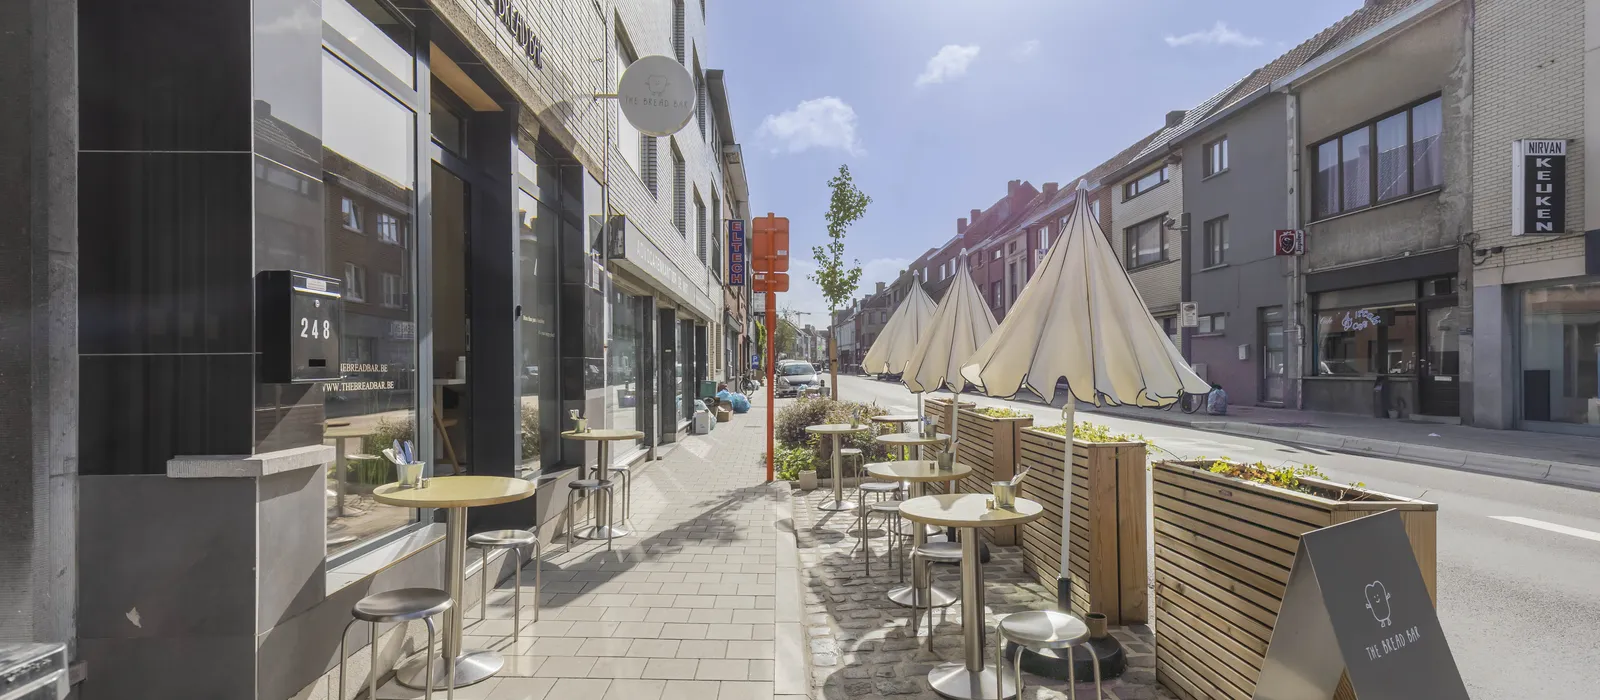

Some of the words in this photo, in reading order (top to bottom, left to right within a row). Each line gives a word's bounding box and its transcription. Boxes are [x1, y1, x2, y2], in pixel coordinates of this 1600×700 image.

[625, 95, 638, 105] THE
[643, 98, 669, 108] BREAD
[673, 101, 688, 109] BAR
[1528, 141, 1562, 154] NIRVAN
[1535, 157, 1553, 231] KEUKEN
[731, 221, 743, 284] ELTECH
[300, 317, 330, 340] 248
[1365, 645, 1381, 661] THE
[1381, 633, 1406, 654] BREAD
[1406, 626, 1420, 643] BAR
